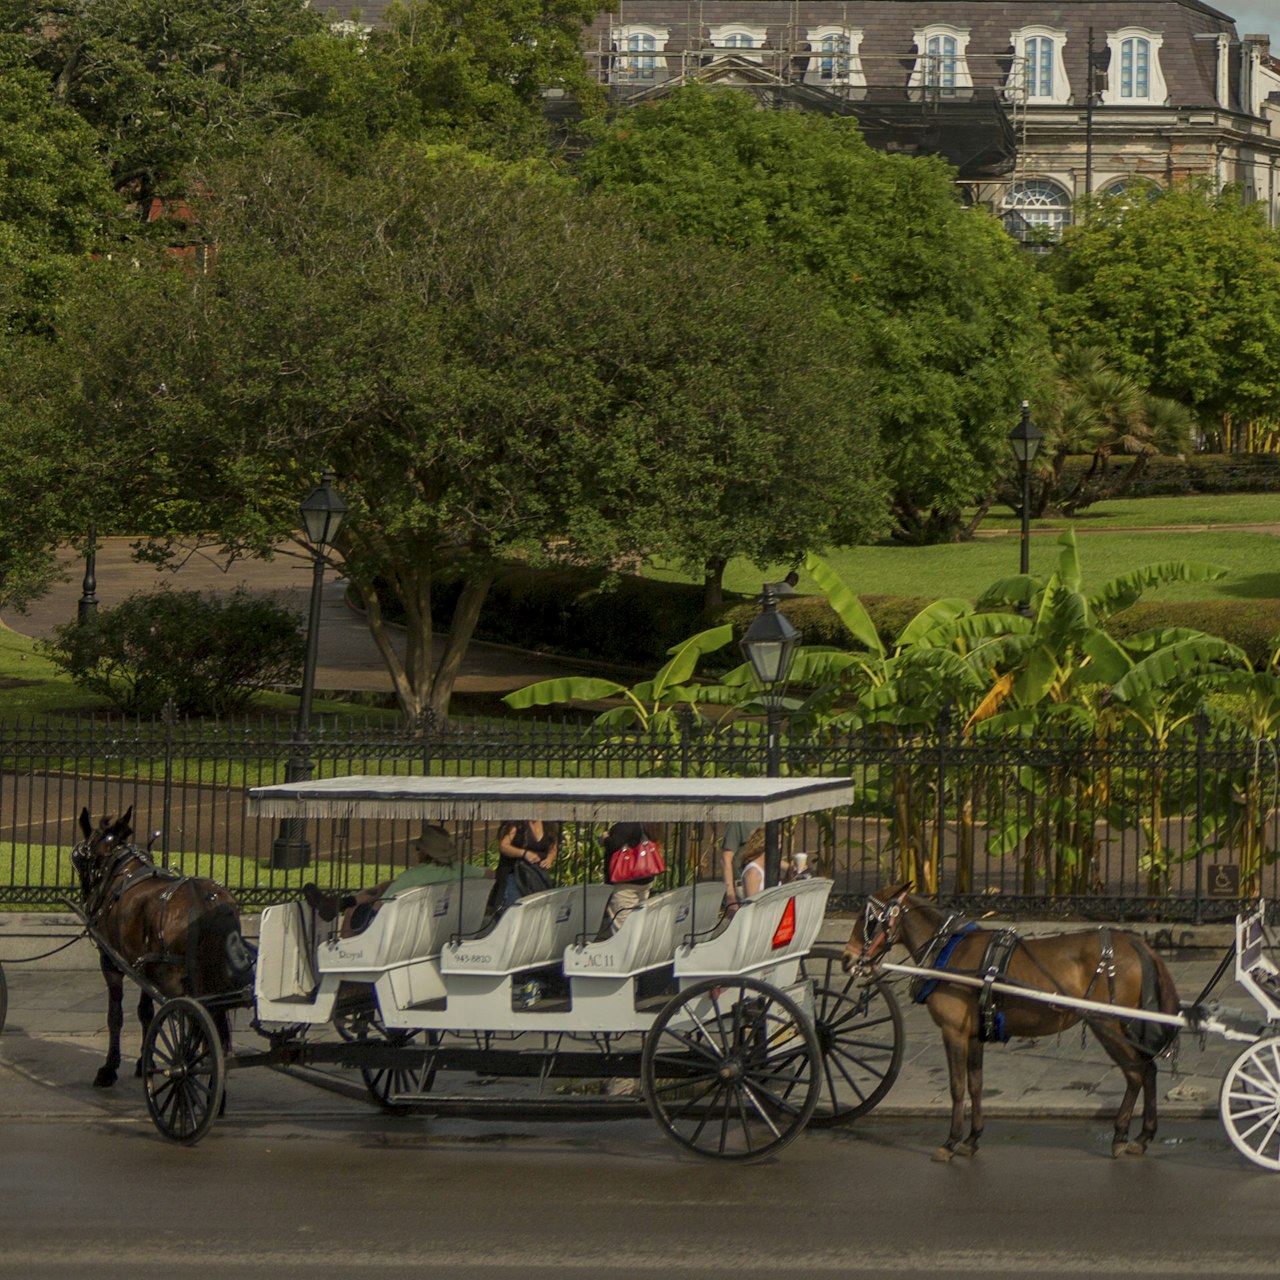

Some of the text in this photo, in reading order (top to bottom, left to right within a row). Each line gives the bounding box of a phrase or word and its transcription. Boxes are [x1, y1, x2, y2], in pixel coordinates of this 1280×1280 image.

[339, 950, 364, 961] Royal
[454, 954, 492, 964] 943-8820
[587, 955, 603, 967] AC
